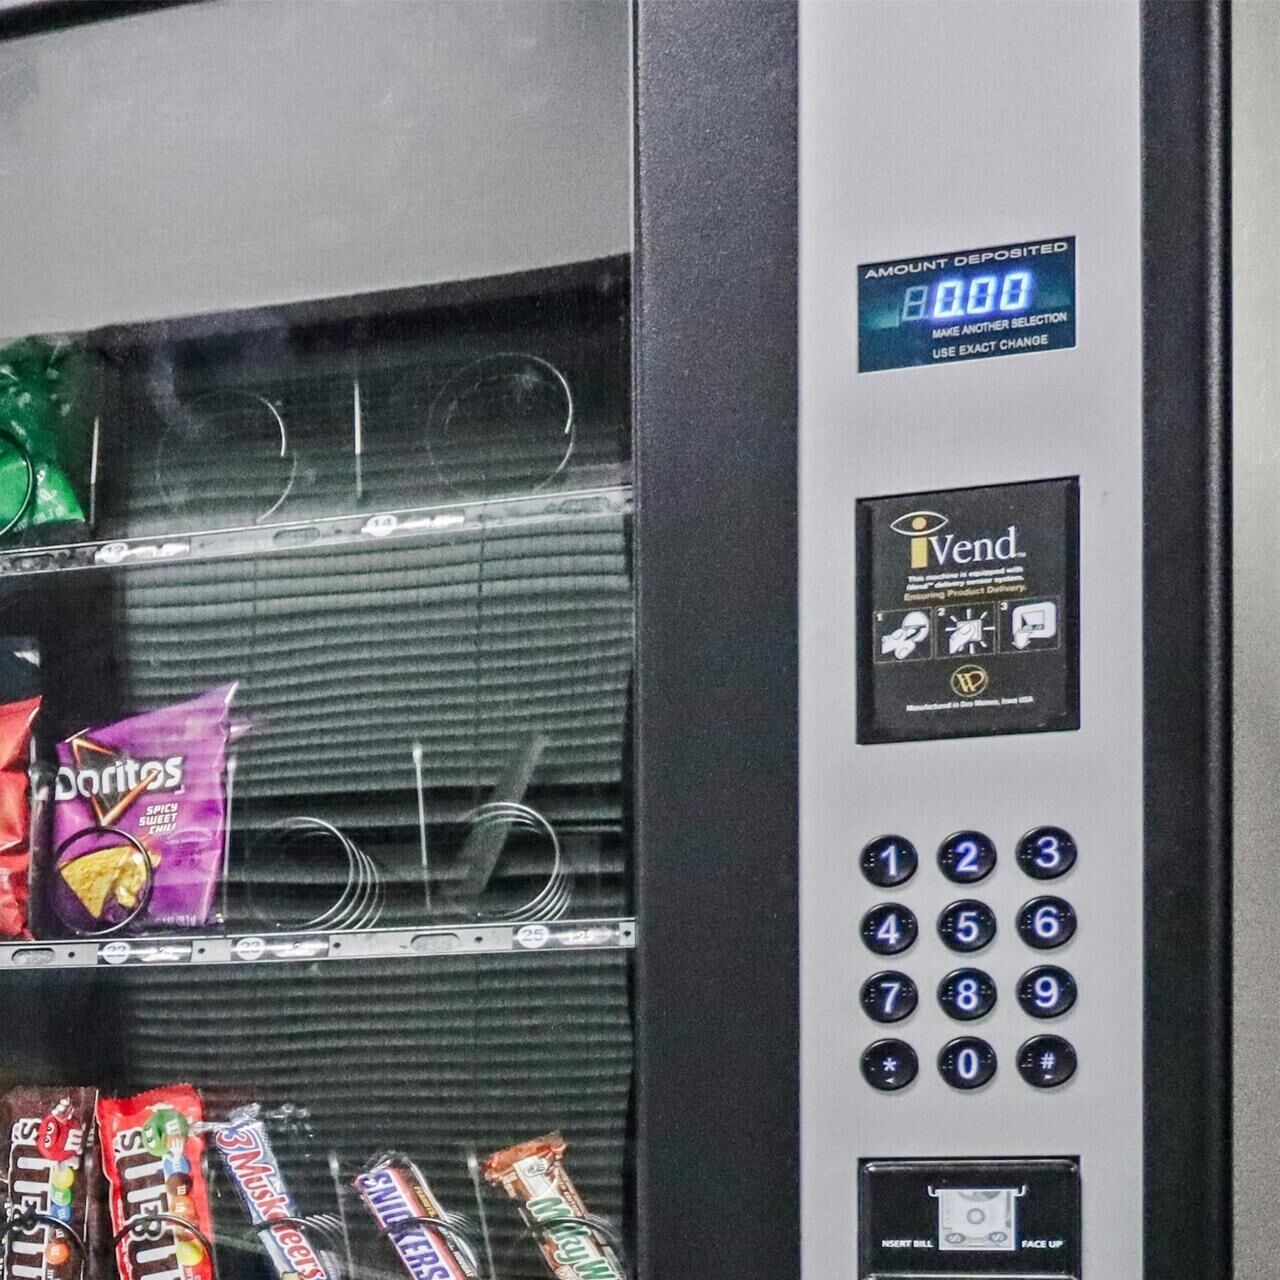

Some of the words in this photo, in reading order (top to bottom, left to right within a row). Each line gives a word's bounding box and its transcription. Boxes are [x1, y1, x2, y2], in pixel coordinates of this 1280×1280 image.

[865, 258, 948, 279] AMOUNT
[954, 242, 1068, 267] DEPOSITED
[932, 329, 960, 339] MAKE
[961, 319, 1010, 335] ANOTHER
[1011, 312, 1067, 329] SELECTION
[932, 349, 956, 359] USE
[959, 341, 996, 356] EXACT
[1000, 334, 1048, 350] CHANGE
[911, 516, 1017, 568] iVend
[904, 591, 945, 601] Ensuring
[947, 588, 985, 598] Product
[987, 584, 1028, 595] Delivery.
[1000, 602, 1008, 611] 3
[937, 608, 946, 617] 2
[55, 757, 183, 801] Doritos
[139, 813, 178, 826] SWEET
[146, 803, 178, 815] SPICY
[148, 823, 177, 835] CHILI
[881, 845, 897, 877] 1
[955, 842, 979, 871] 2
[1036, 836, 1060, 867] 3
[522, 928, 544, 942] 25
[877, 914, 900, 944] 4
[956, 911, 978, 942] 5
[1034, 906, 1060, 938] 6
[880, 983, 900, 1013] 7
[957, 979, 978, 1010] 8
[1034, 976, 1059, 1008] 9
[957, 1049, 978, 1079] 0
[1040, 1052, 1055, 1069] #
[913, 1240, 934, 1248] BILL
[1021, 1239, 1046, 1248] FACE
[1048, 1240, 1064, 1248] UP
